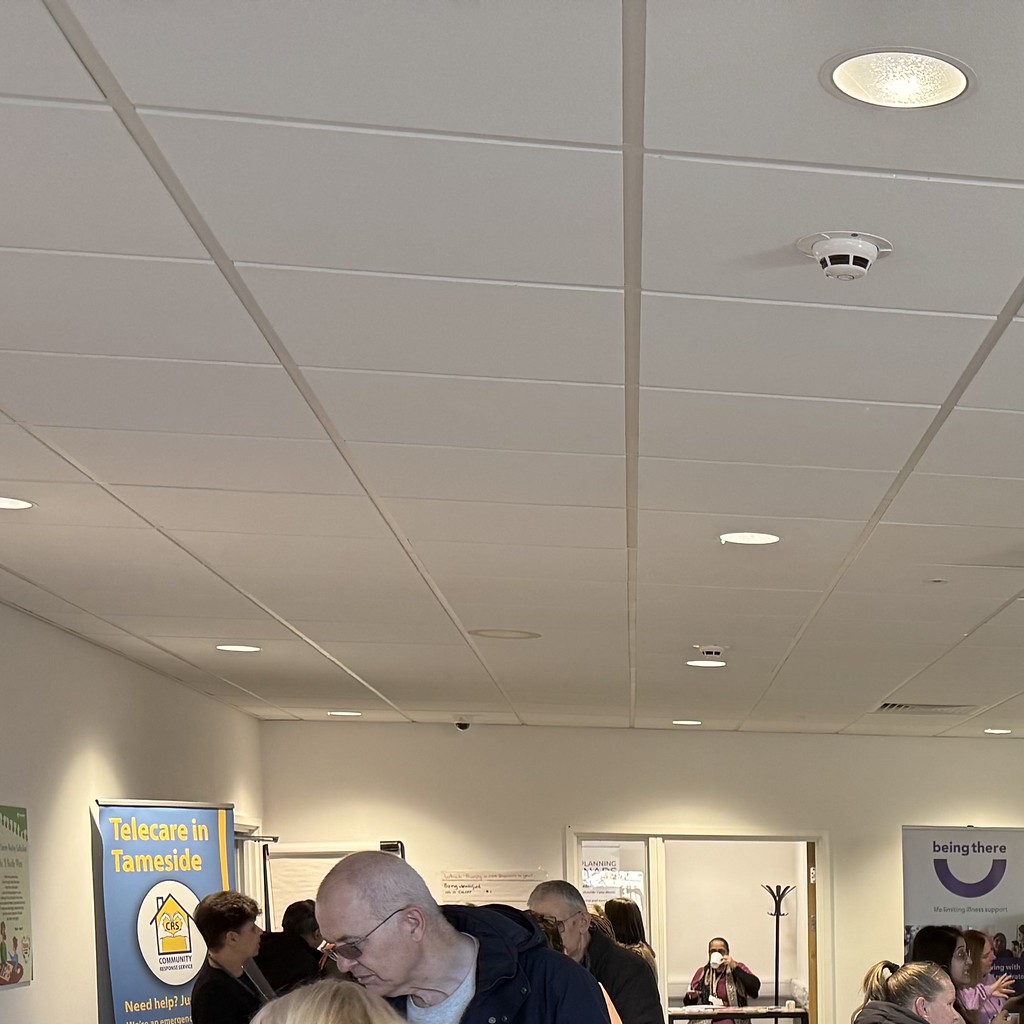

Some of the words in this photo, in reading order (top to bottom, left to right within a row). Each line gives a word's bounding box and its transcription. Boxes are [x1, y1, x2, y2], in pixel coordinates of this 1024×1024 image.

[109, 816, 189, 841] Telecare
[191, 818, 209, 841] in
[932, 840, 970, 856] being
[972, 840, 1007, 853] there
[111, 848, 203, 872] Tameside
[943, 906, 965, 914] limiting
[165, 921, 179, 931] CRS
[158, 955, 192, 965] COMMUNITY
[124, 999, 153, 1013] Need
[154, 995, 179, 1010] help?
